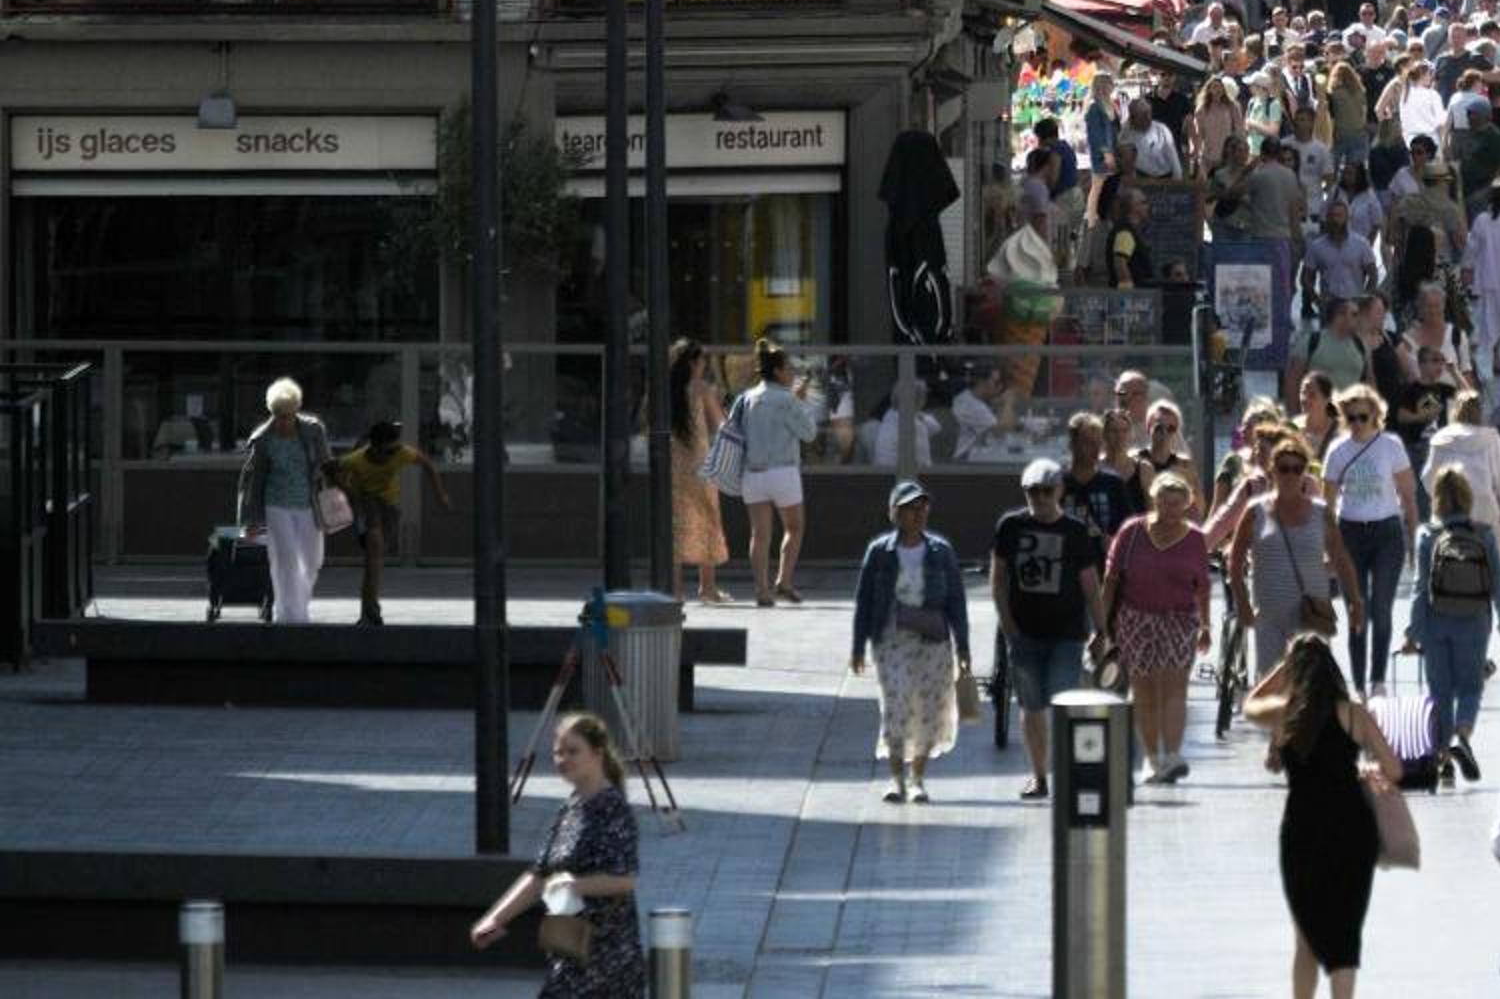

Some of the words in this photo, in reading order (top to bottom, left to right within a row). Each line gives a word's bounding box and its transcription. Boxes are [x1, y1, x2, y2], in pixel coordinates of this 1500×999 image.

[36, 128, 71, 159] ijs
[80, 129, 176, 159] glaces
[236, 128, 340, 154] snacks
[715, 125, 824, 150] restaurant
